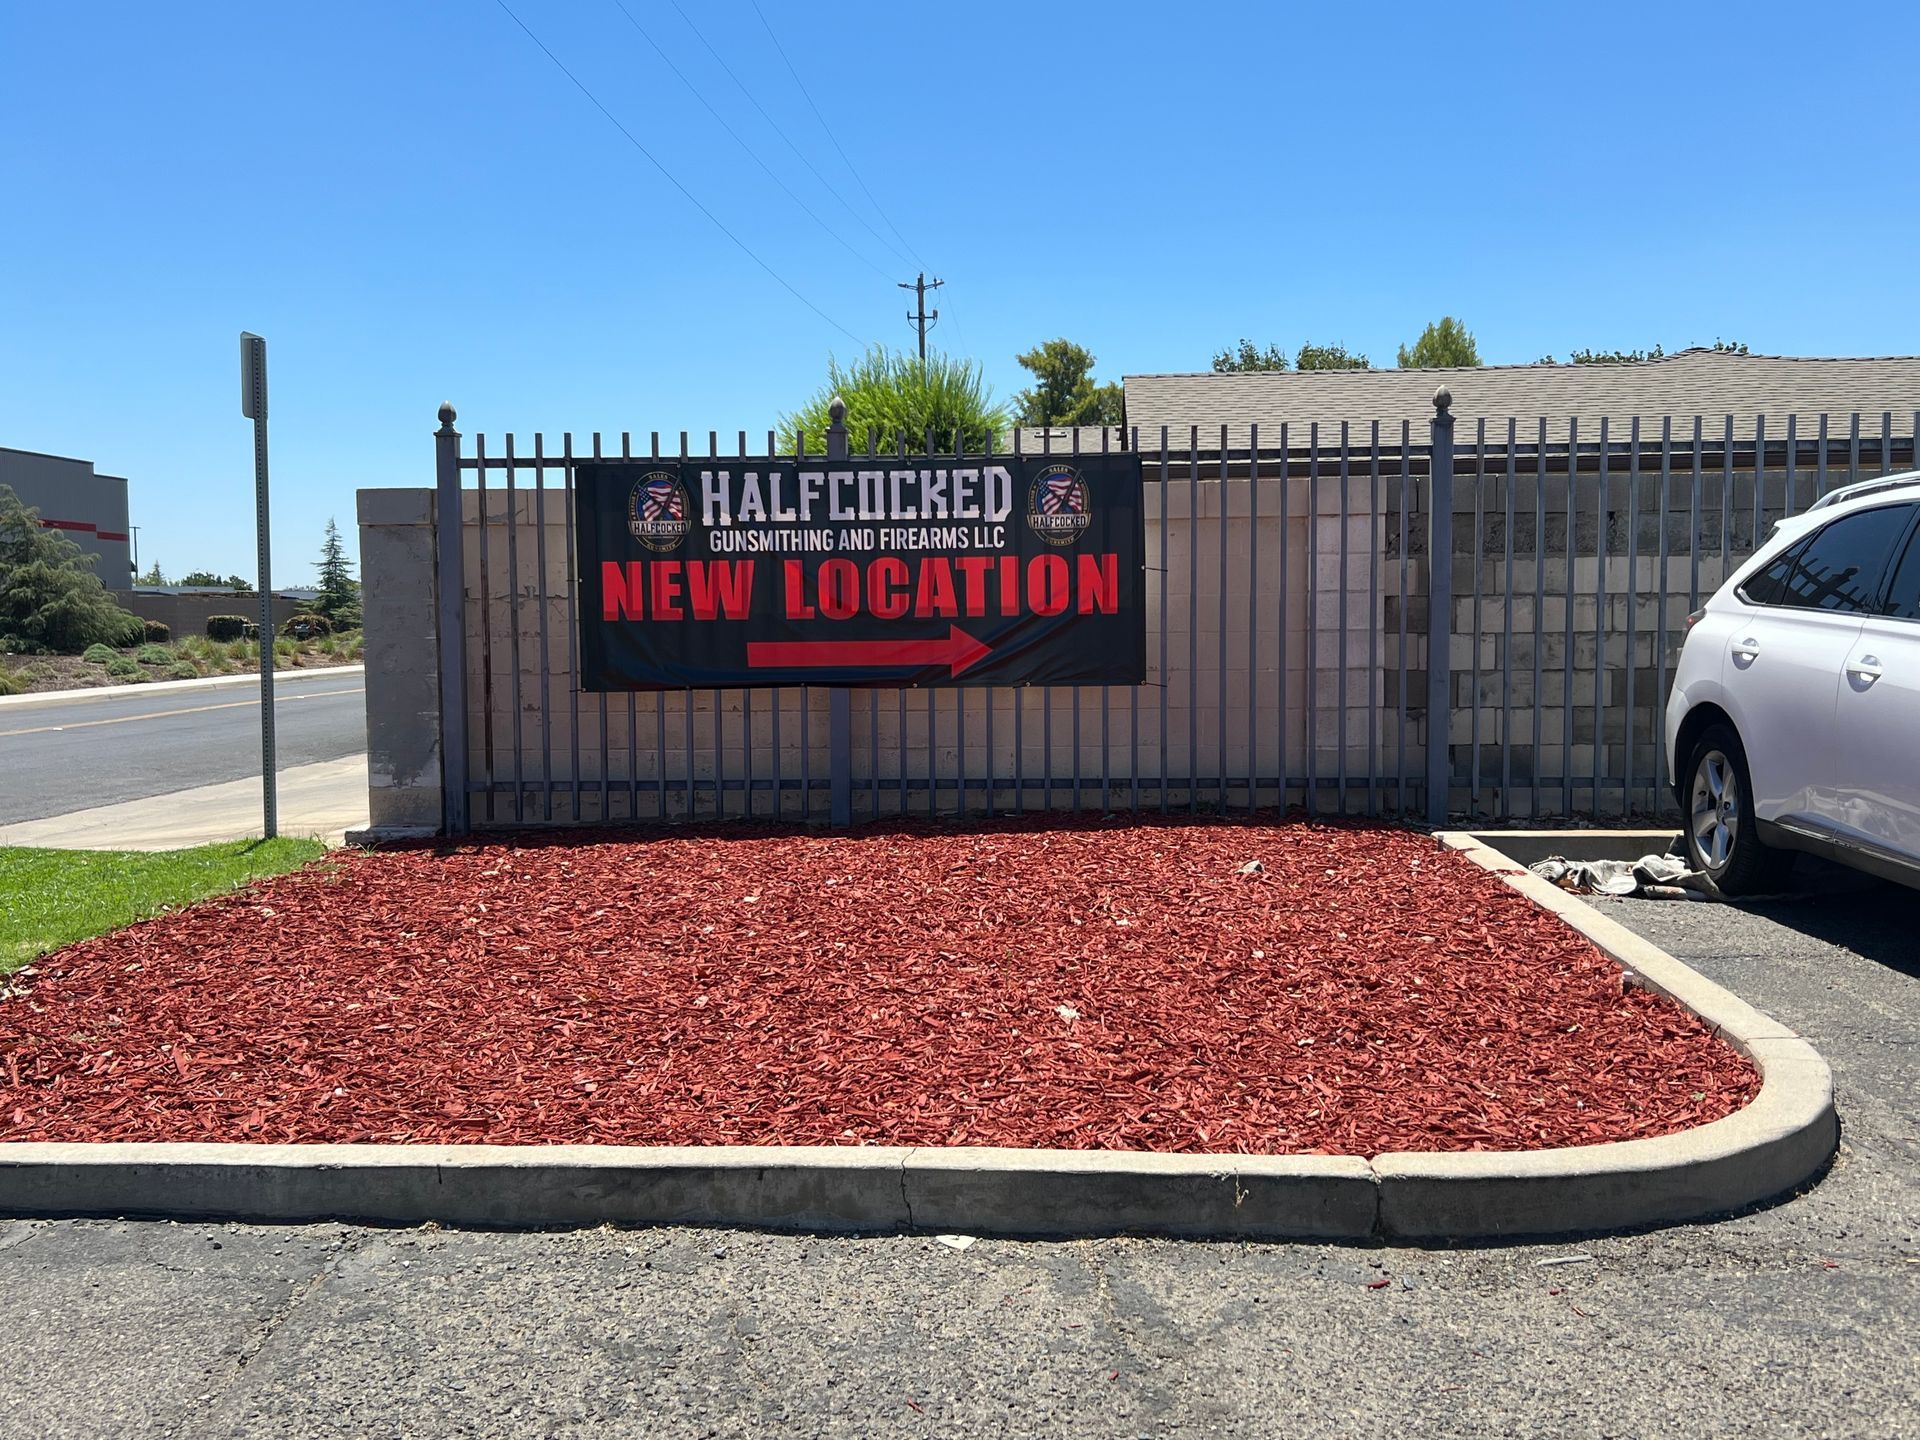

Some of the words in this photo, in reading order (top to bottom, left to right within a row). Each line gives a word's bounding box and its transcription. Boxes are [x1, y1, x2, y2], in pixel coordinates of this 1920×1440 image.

[701, 466, 1012, 527] HALFCOCKED
[634, 522, 687, 534] HALFCOCKED
[1033, 515, 1086, 528] HALFCOCKED
[709, 530, 834, 552] GUNSMITHING
[839, 528, 875, 551] AND
[880, 527, 969, 550] FIREARMS
[974, 525, 1005, 549] LLC
[602, 560, 755, 621] NEW
[784, 553, 1119, 620] LOCATION
